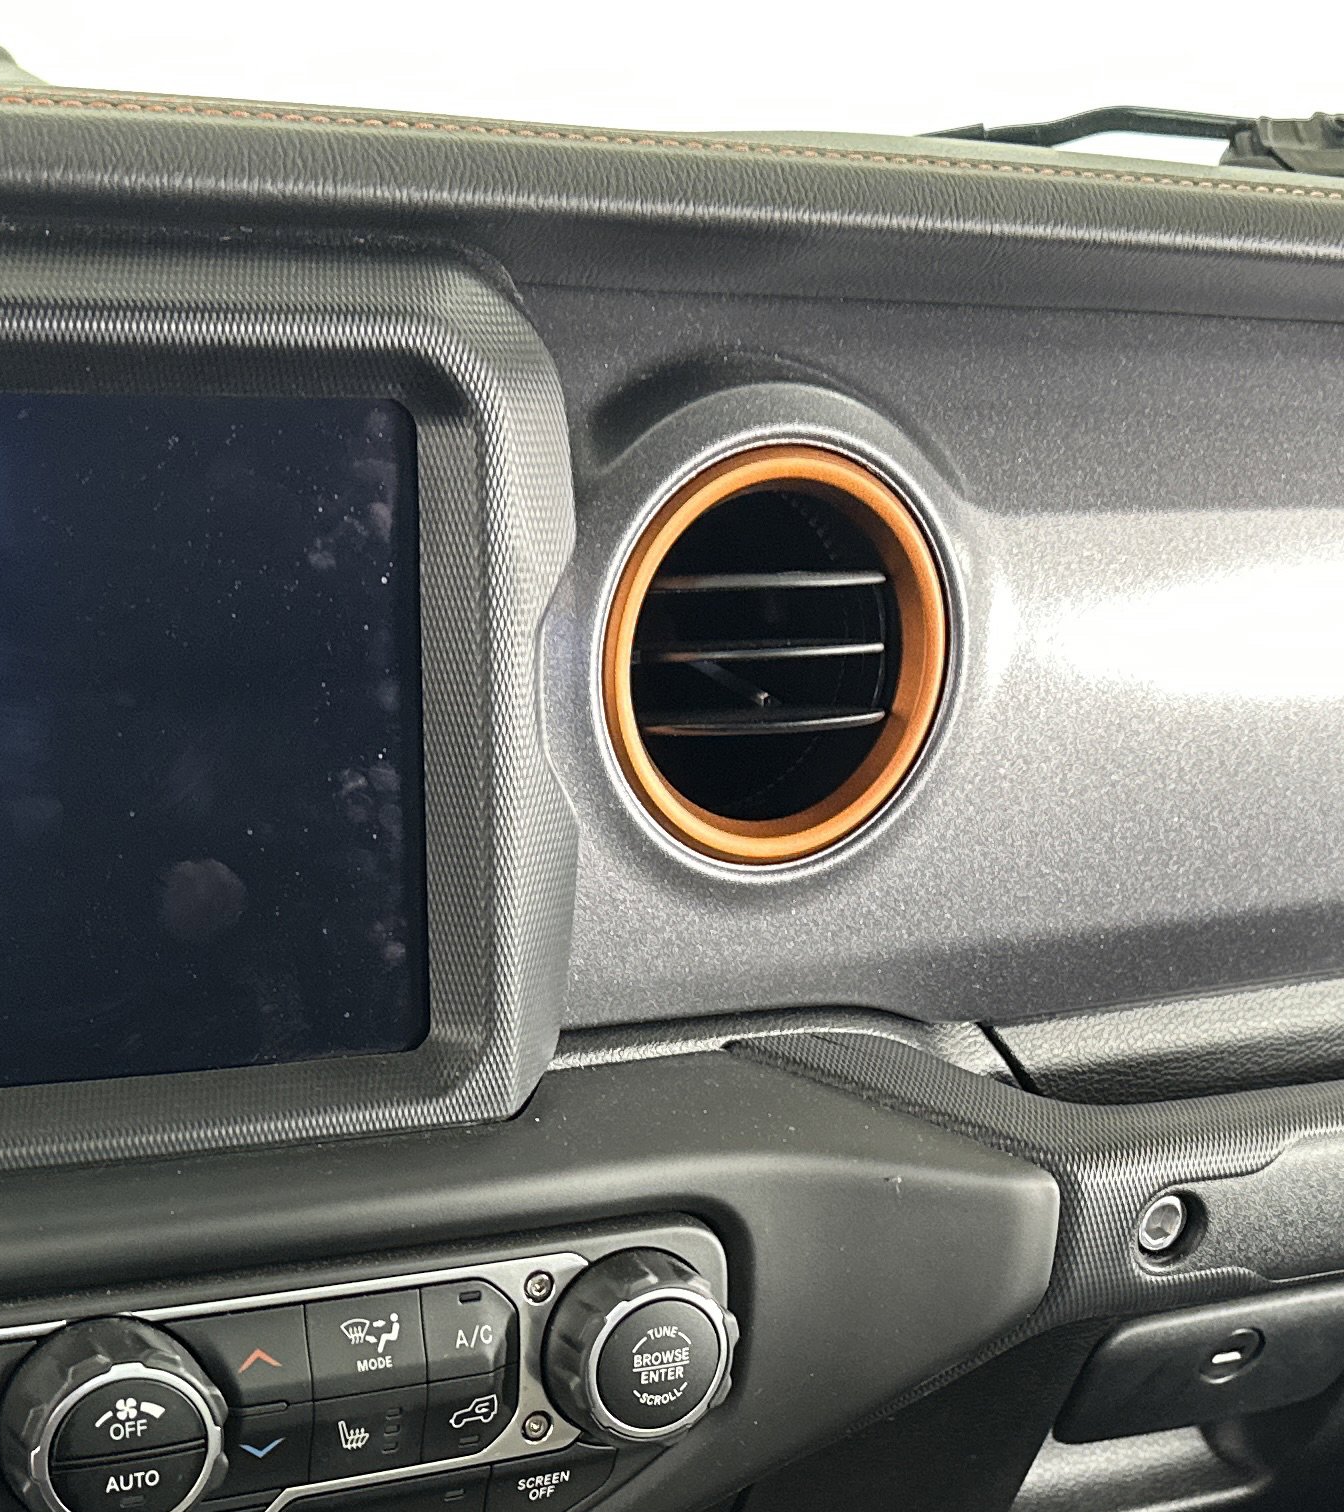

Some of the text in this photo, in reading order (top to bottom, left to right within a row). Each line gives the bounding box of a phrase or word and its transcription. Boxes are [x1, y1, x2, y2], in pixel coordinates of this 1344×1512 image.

[455, 1324, 494, 1349] A/C
[647, 1326, 678, 1340] TUNE
[356, 1356, 393, 1372] MODE
[633, 1347, 690, 1368] BROWSE
[640, 1366, 684, 1384] ENTER
[639, 1388, 683, 1405] SCROLL
[109, 1419, 148, 1441] OFF
[105, 1469, 160, 1494] AUTO
[517, 1470, 570, 1494] SCREEN
[528, 1483, 556, 1501] OFF
